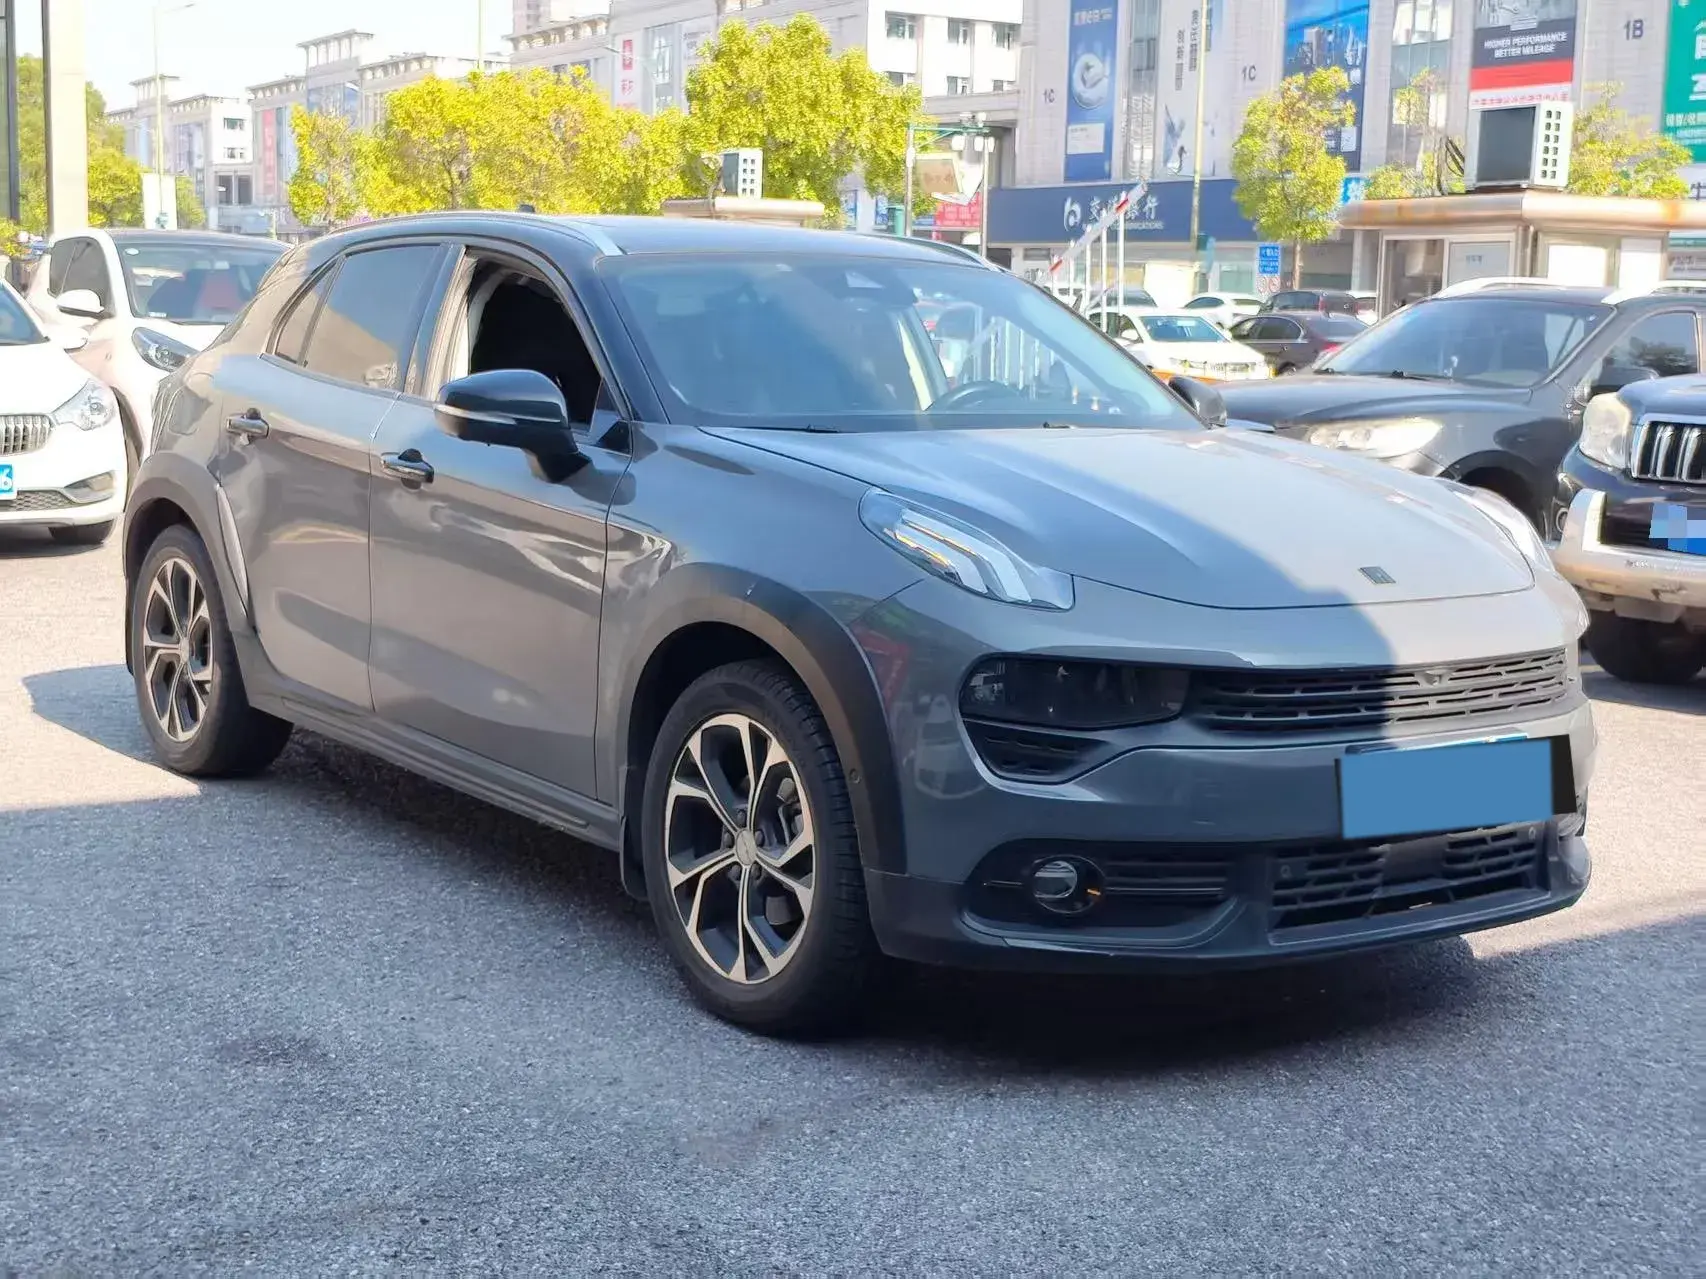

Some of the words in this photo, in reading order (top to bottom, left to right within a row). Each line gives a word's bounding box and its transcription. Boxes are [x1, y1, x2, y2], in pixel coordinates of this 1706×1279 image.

[1623, 18, 1644, 41] 1B
[1512, 31, 1569, 46] PERFORMANCE
[1494, 47, 1521, 58] BETTER
[1522, 44, 1556, 56] MILEAGE
[1242, 65, 1257, 82] 1C
[1042, 88, 1056, 104] 1C
